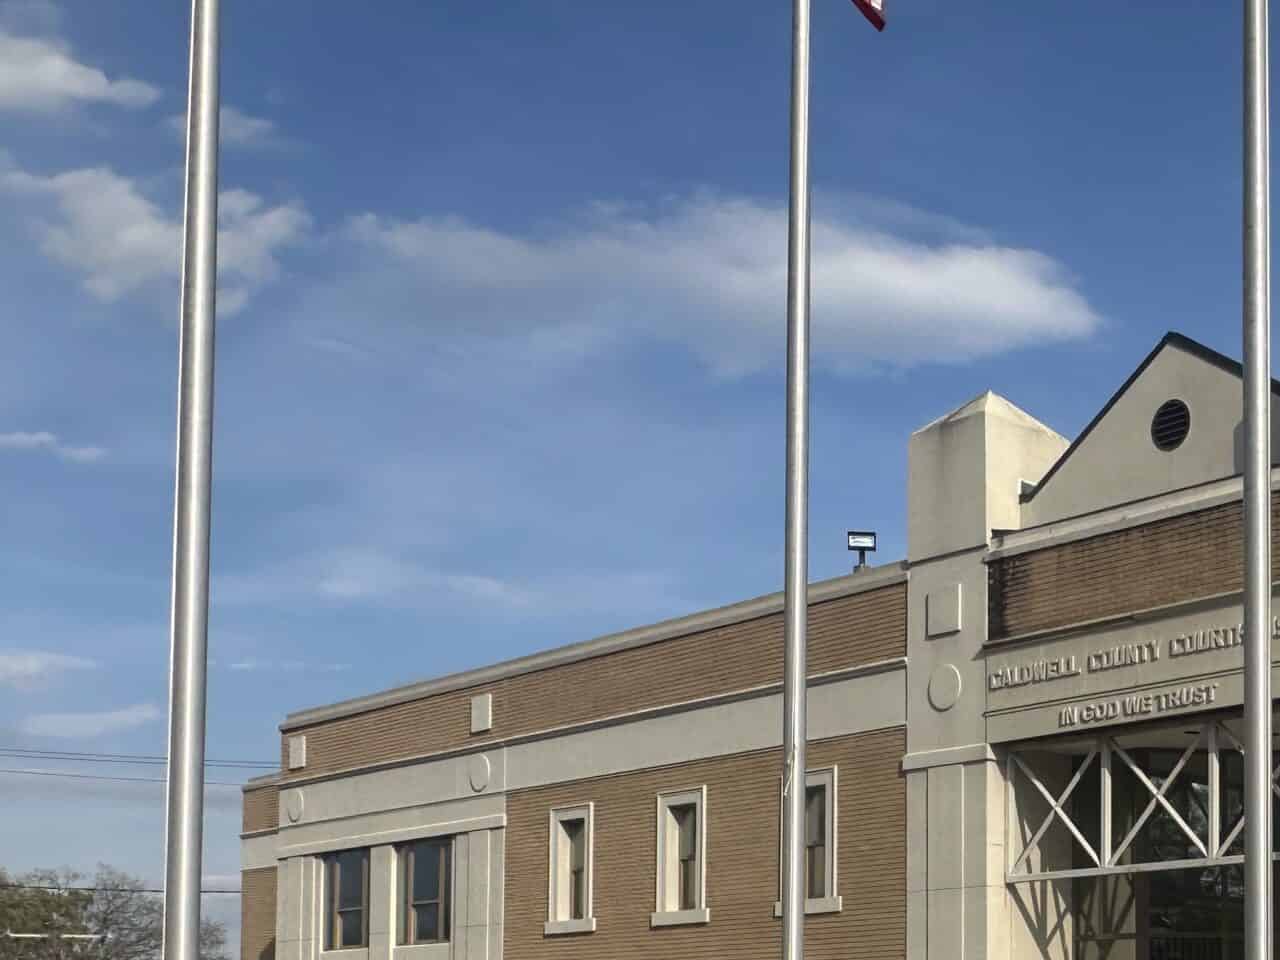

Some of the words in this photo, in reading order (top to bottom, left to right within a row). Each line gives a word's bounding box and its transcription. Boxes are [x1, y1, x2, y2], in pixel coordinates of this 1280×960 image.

[990, 655, 1081, 691] CALDWELL
[1088, 639, 1160, 673] COUNTY
[1058, 705, 1079, 728] IN
[1080, 700, 1120, 724] GOD
[1121, 693, 1153, 718] WE
[1154, 682, 1219, 712] TRUST
